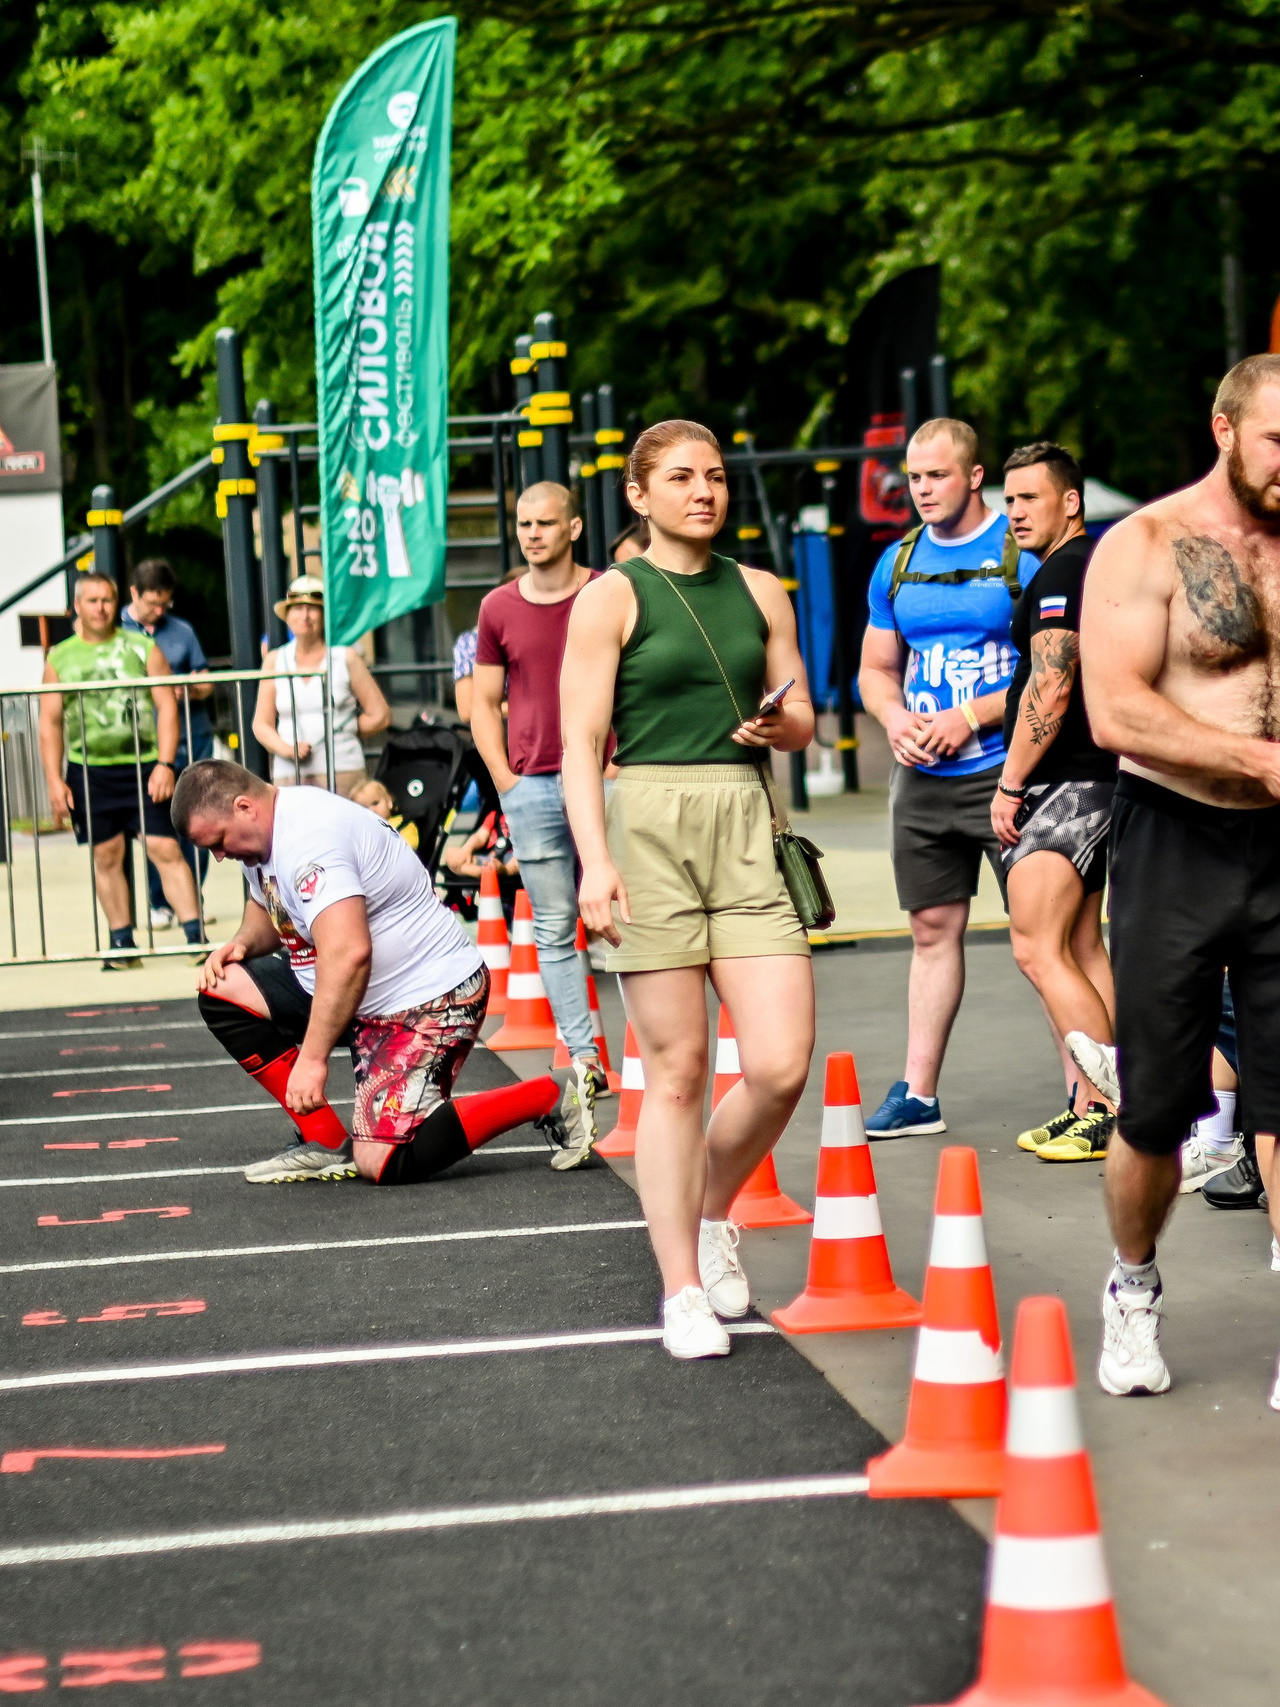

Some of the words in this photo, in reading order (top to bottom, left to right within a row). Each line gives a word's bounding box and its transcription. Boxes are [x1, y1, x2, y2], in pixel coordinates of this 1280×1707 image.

[343, 506, 376, 542] 20
[348, 542, 378, 578] 23
[37, 1205, 192, 1227] 5
[0, 1444, 226, 1473] 7
